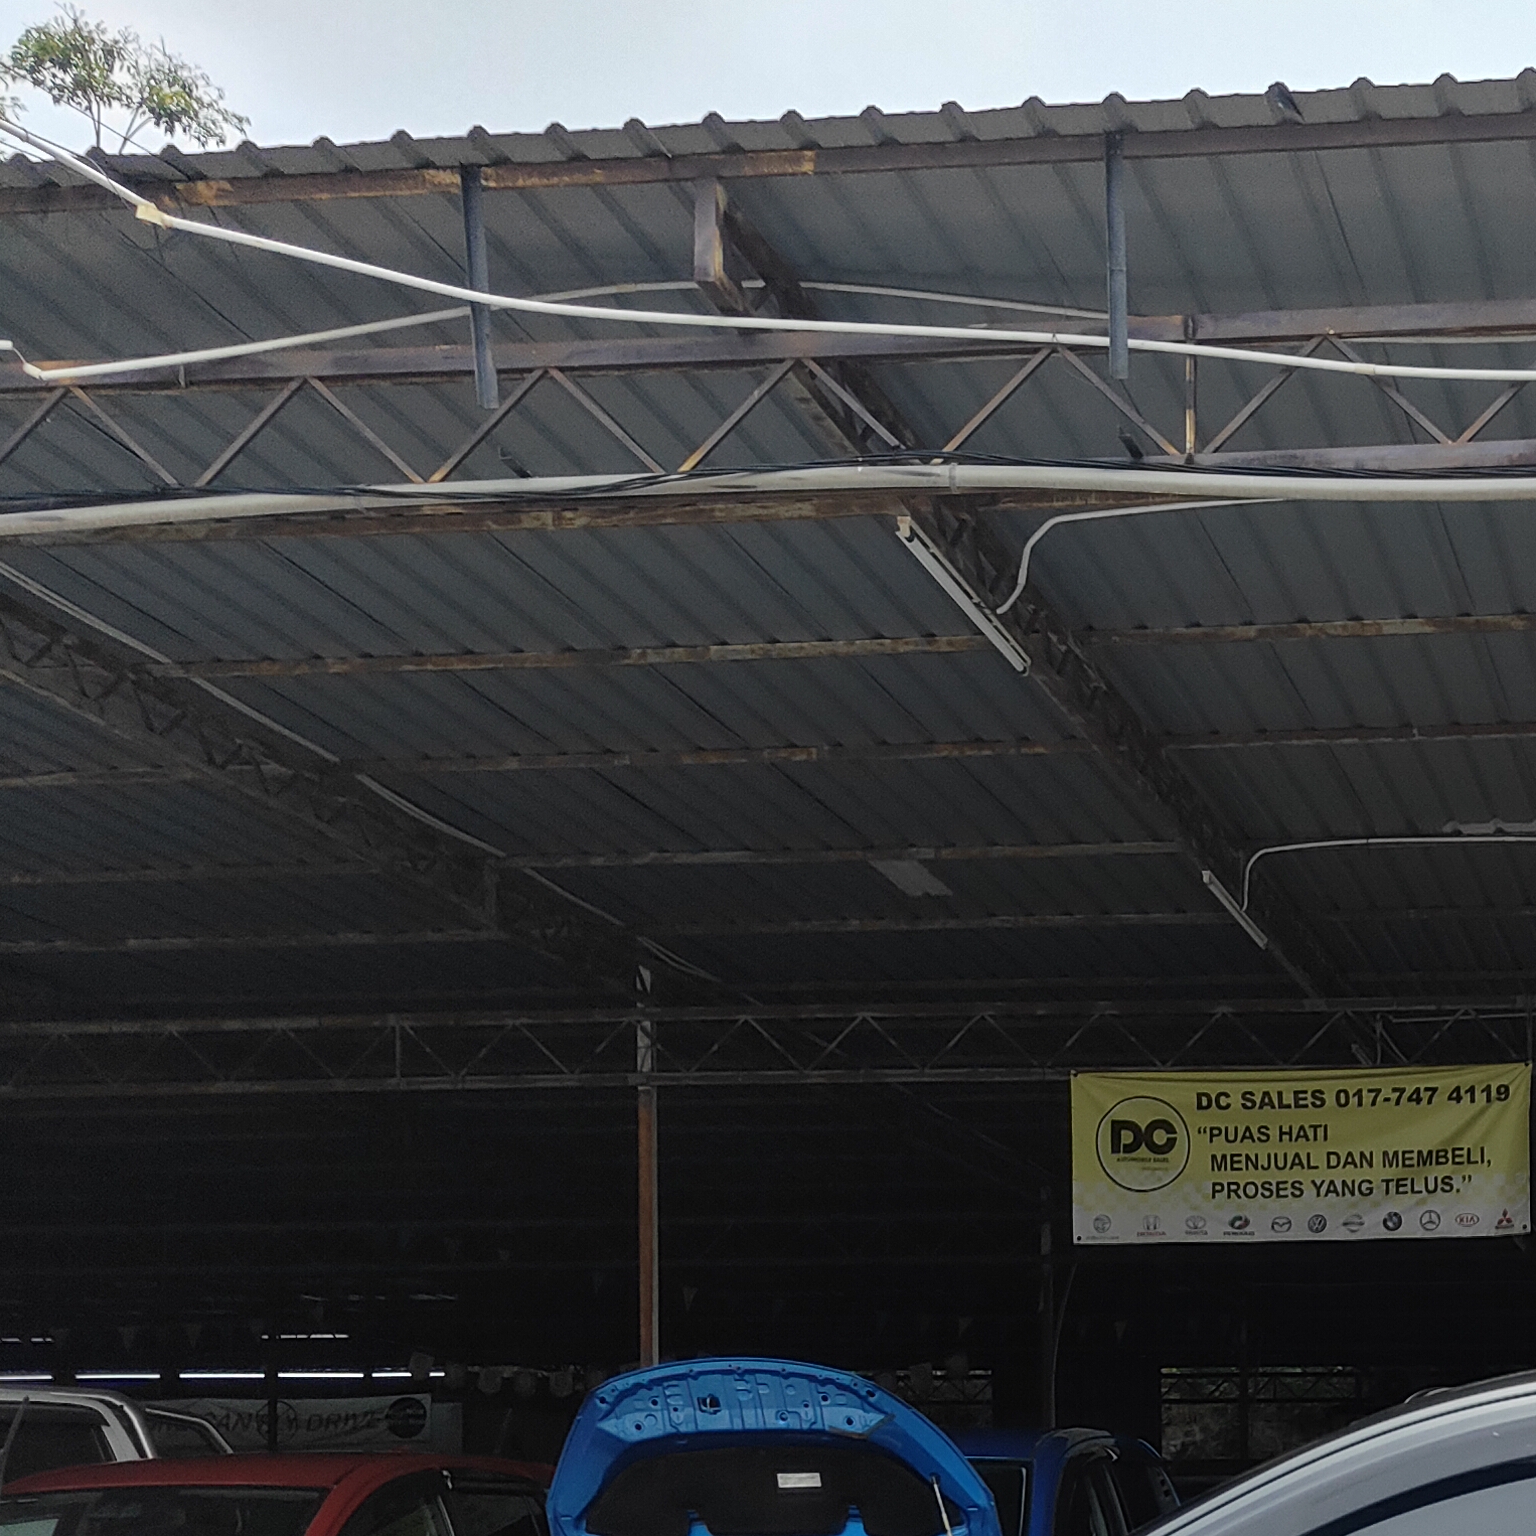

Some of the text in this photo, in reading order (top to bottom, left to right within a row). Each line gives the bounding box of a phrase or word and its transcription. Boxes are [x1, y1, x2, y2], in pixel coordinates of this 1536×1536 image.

[1196, 1083, 1511, 1111] DC SALES 017-747 4119
[1110, 1119, 1177, 1155] DC
[1277, 1124, 1329, 1143] HATI
[1210, 1146, 1493, 1172] MENJUAL DAN MEMBELI,
[1211, 1179, 1305, 1200] PROSES
[1311, 1178, 1374, 1198] YANG
